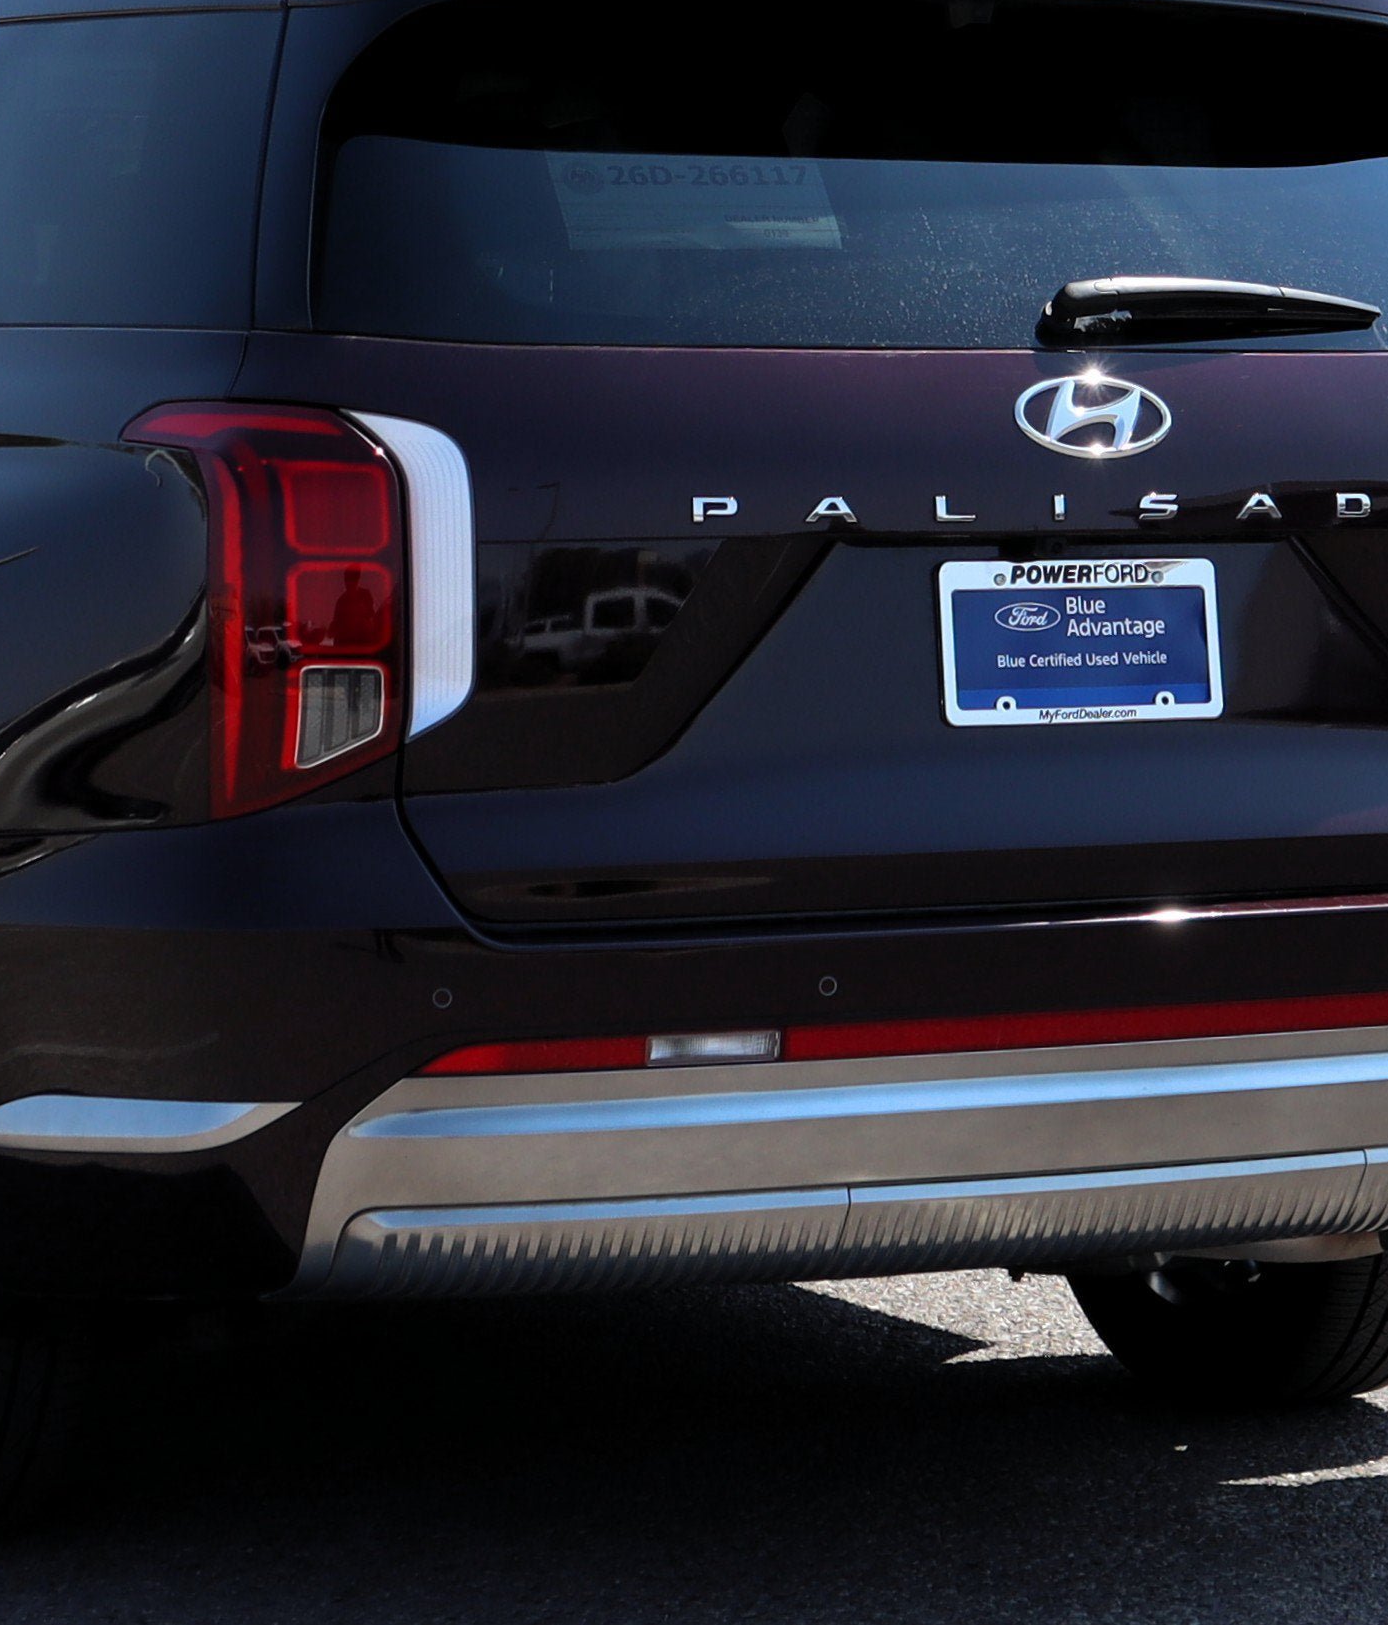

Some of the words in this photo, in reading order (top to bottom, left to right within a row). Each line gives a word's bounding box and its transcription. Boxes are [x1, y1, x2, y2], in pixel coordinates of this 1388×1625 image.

[1010, 563, 1149, 585] POWERFORD
[1065, 596, 1106, 615] Blue
[1008, 606, 1049, 627] Ford
[1066, 617, 1165, 639] Advantage
[997, 654, 1026, 668] Blue
[1029, 652, 1082, 667] Certified
[1086, 652, 1119, 666] Used
[1124, 651, 1167, 665] Vehicle
[1039, 707, 1137, 724] MyFordDealer.com
